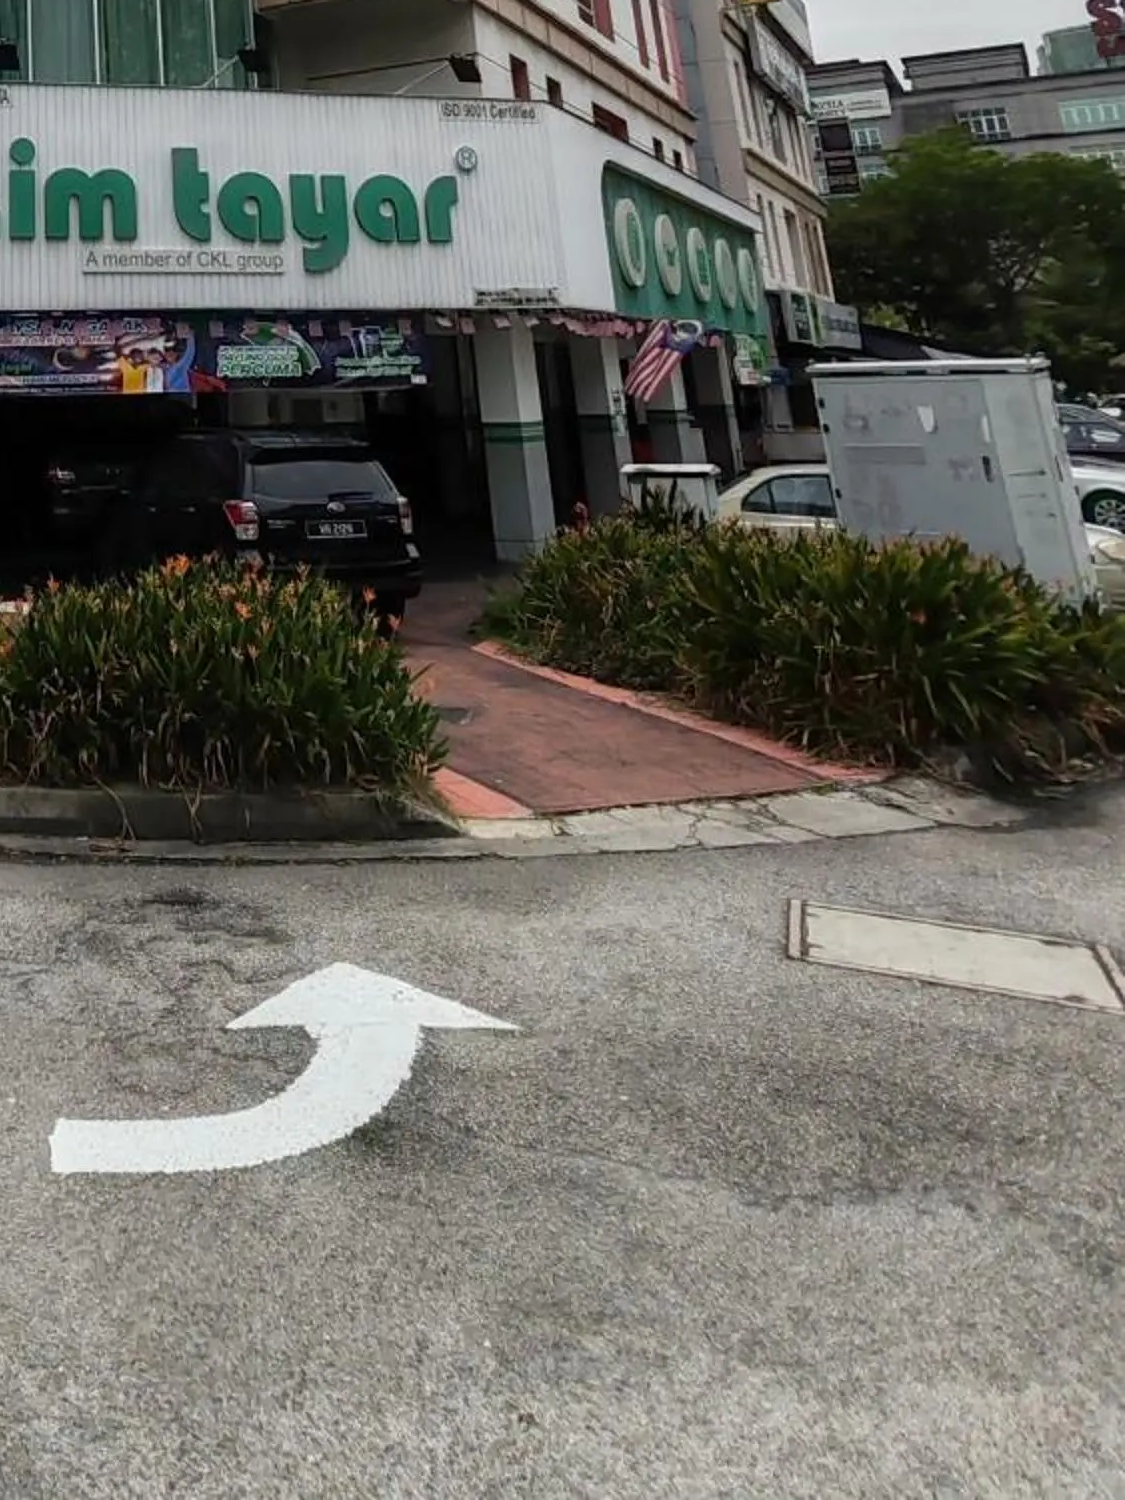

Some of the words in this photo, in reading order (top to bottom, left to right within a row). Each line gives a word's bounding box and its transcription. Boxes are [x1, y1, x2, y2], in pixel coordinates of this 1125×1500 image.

[441, 102, 460, 117] ISO
[463, 103, 488, 118] 9001
[490, 103, 536, 119] Certified
[170, 147, 459, 274] tayar
[85, 252, 99, 267] A
[103, 251, 172, 267] member
[176, 251, 193, 267] of
[197, 251, 231, 268] CKL
[237, 254, 284, 271] group
